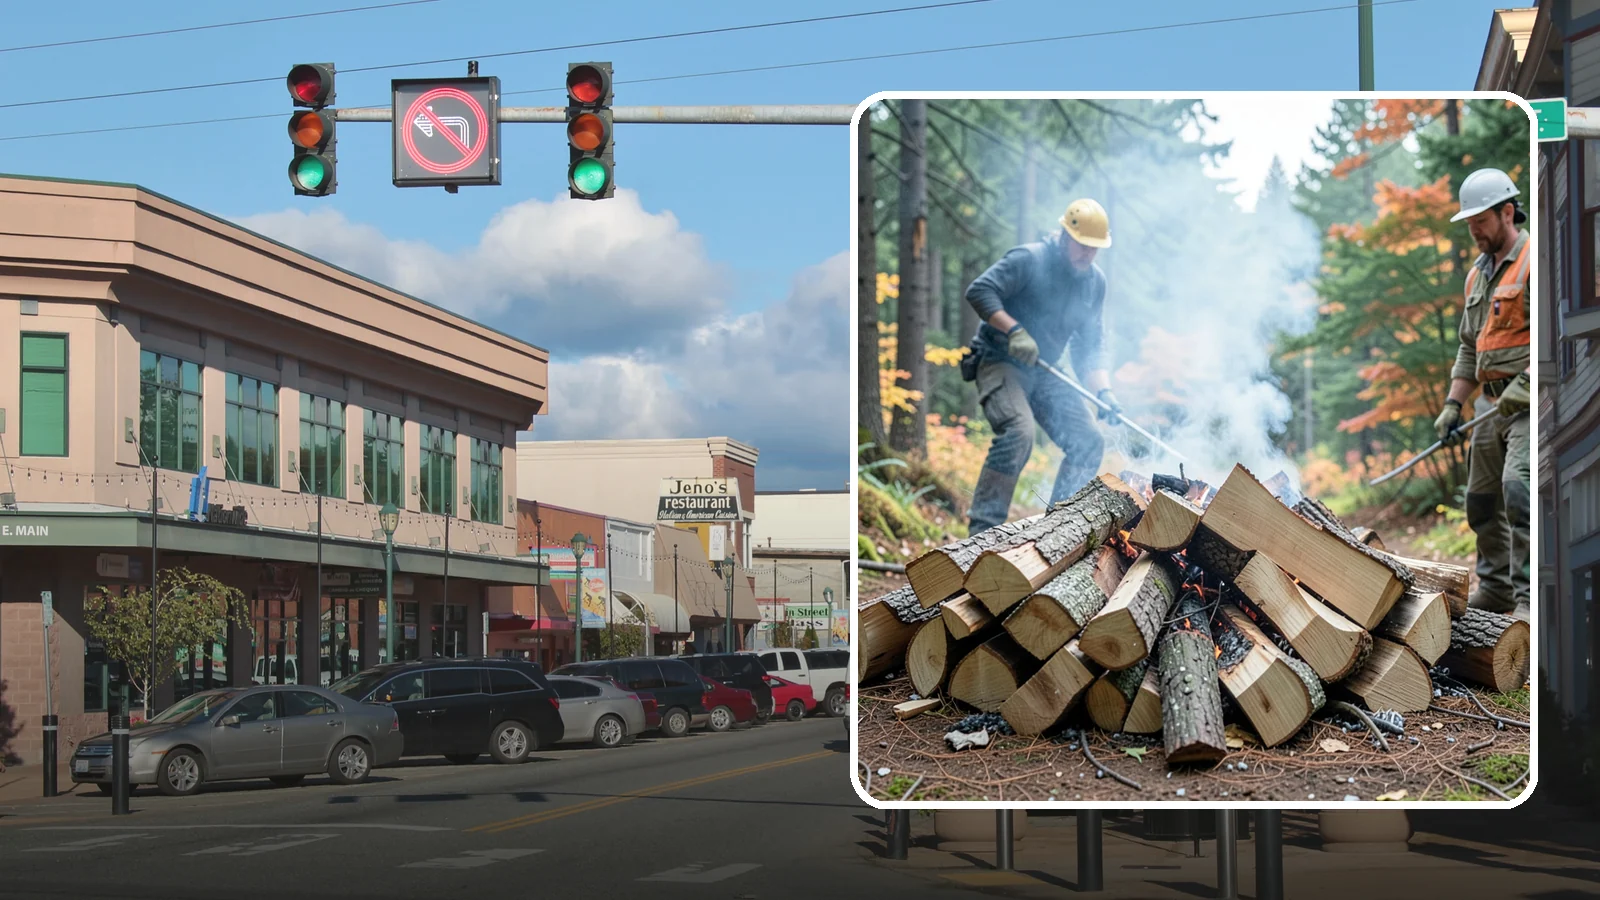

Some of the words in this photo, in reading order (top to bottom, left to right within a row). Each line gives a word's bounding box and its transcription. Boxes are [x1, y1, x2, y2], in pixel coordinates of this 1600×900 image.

[669, 479, 728, 495] Jeno's
[665, 496, 731, 509] restaurant
[658, 510, 682, 519] Italian
[686, 510, 714, 519] American
[715, 509, 738, 519] Cuisine
[2, 525, 13, 536] E.
[15, 525, 49, 536] MAIN
[797, 607, 828, 617] Street
